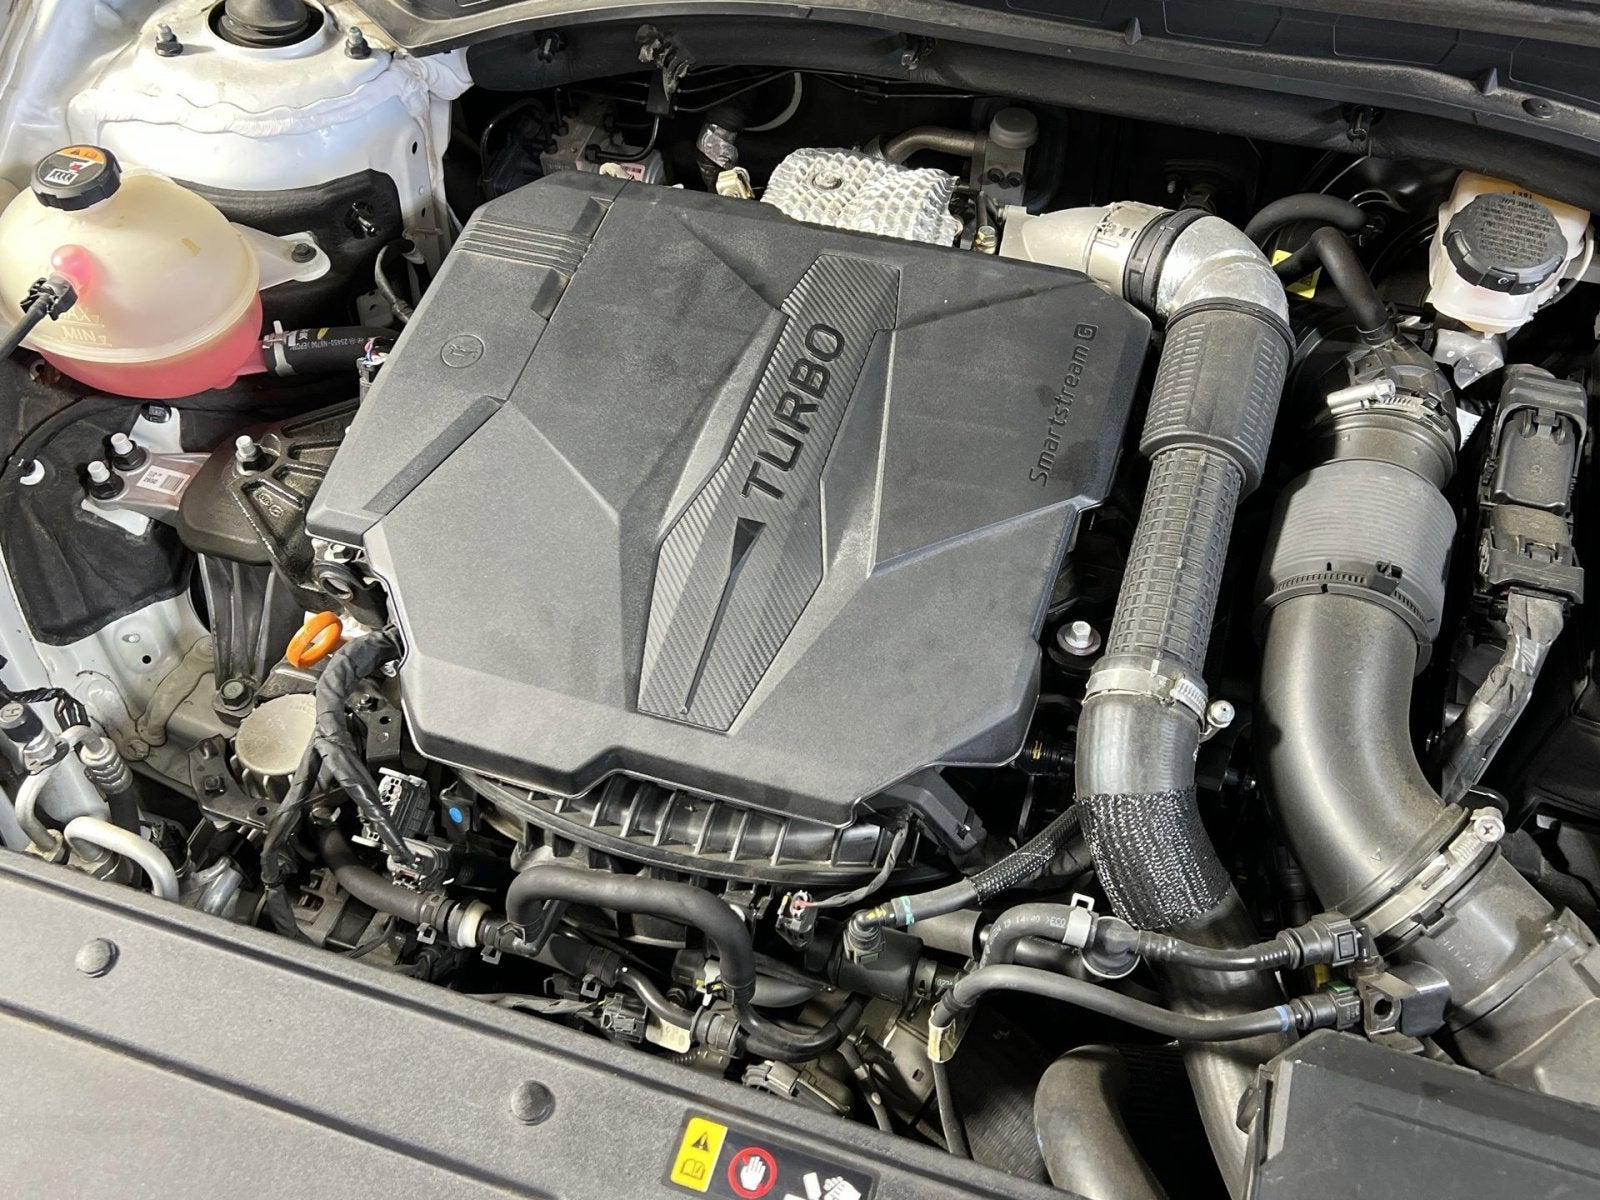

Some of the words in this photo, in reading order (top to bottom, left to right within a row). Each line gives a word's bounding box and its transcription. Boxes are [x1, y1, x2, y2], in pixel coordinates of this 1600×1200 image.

[60, 325, 97, 342] MIN
[741, 323, 846, 500] TURBO
[1028, 344, 1090, 487] Smartstream
